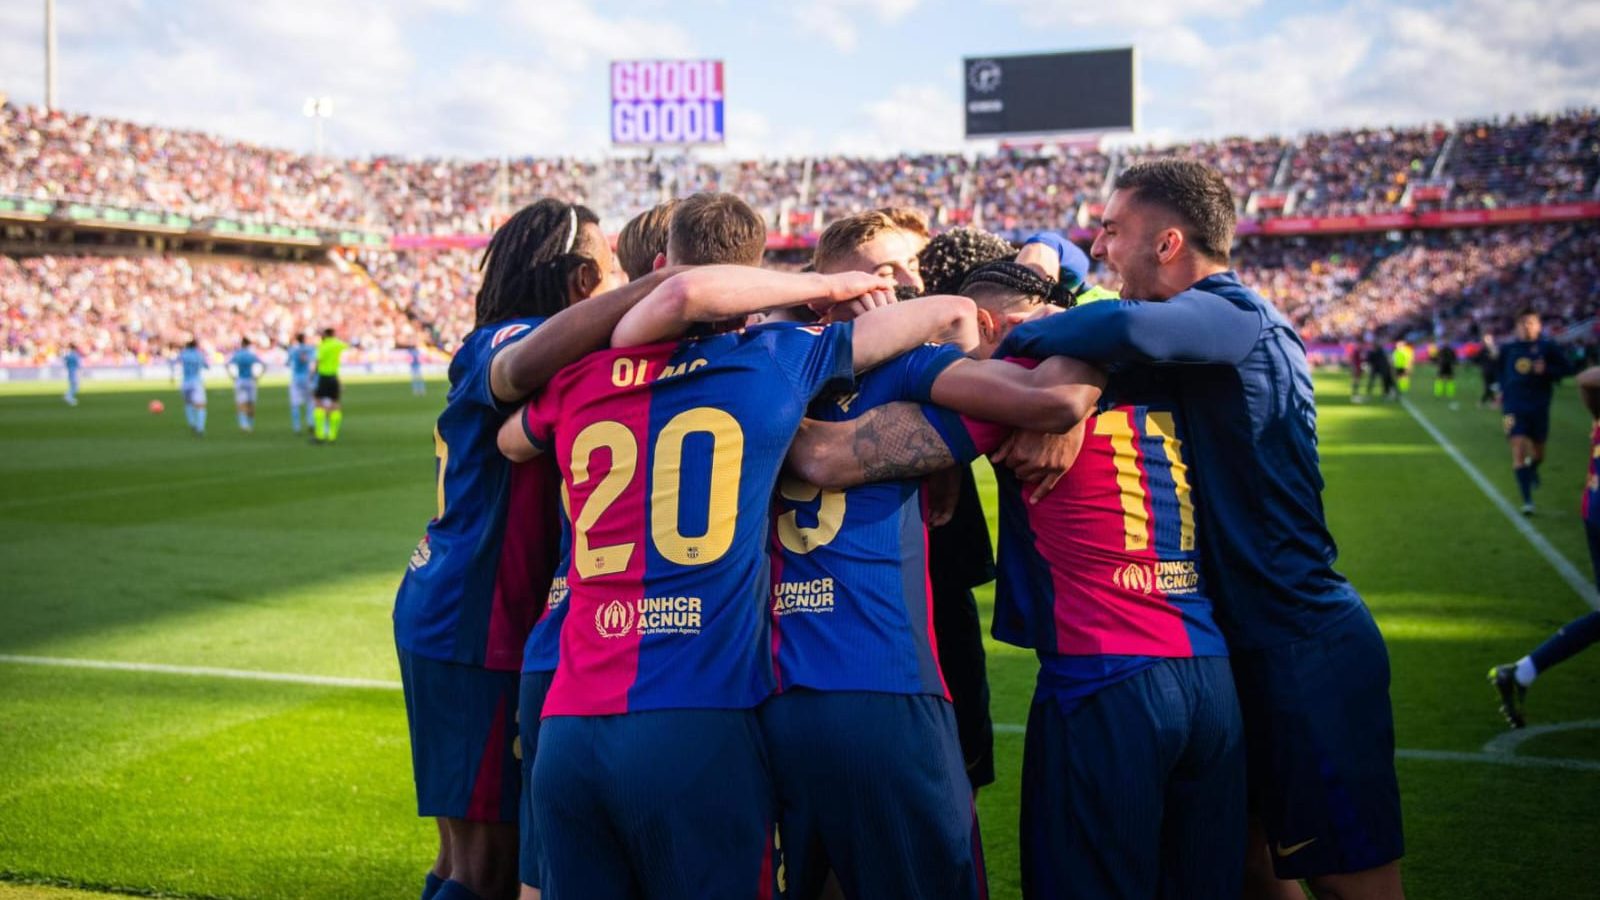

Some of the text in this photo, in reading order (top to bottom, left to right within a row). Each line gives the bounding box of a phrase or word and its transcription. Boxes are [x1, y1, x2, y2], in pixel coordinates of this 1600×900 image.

[614, 61, 723, 99] GOOOL
[614, 102, 723, 141] GOOOL
[1093, 411, 1195, 551] 11
[570, 407, 744, 580] 20
[1154, 561, 1195, 576] UNHCR
[774, 578, 834, 596] UNHCR
[1156, 573, 1198, 590] ACNUR
[637, 597, 702, 613] UNHCR
[773, 592, 834, 610] ACNUR
[637, 612, 701, 628] ACNUR
